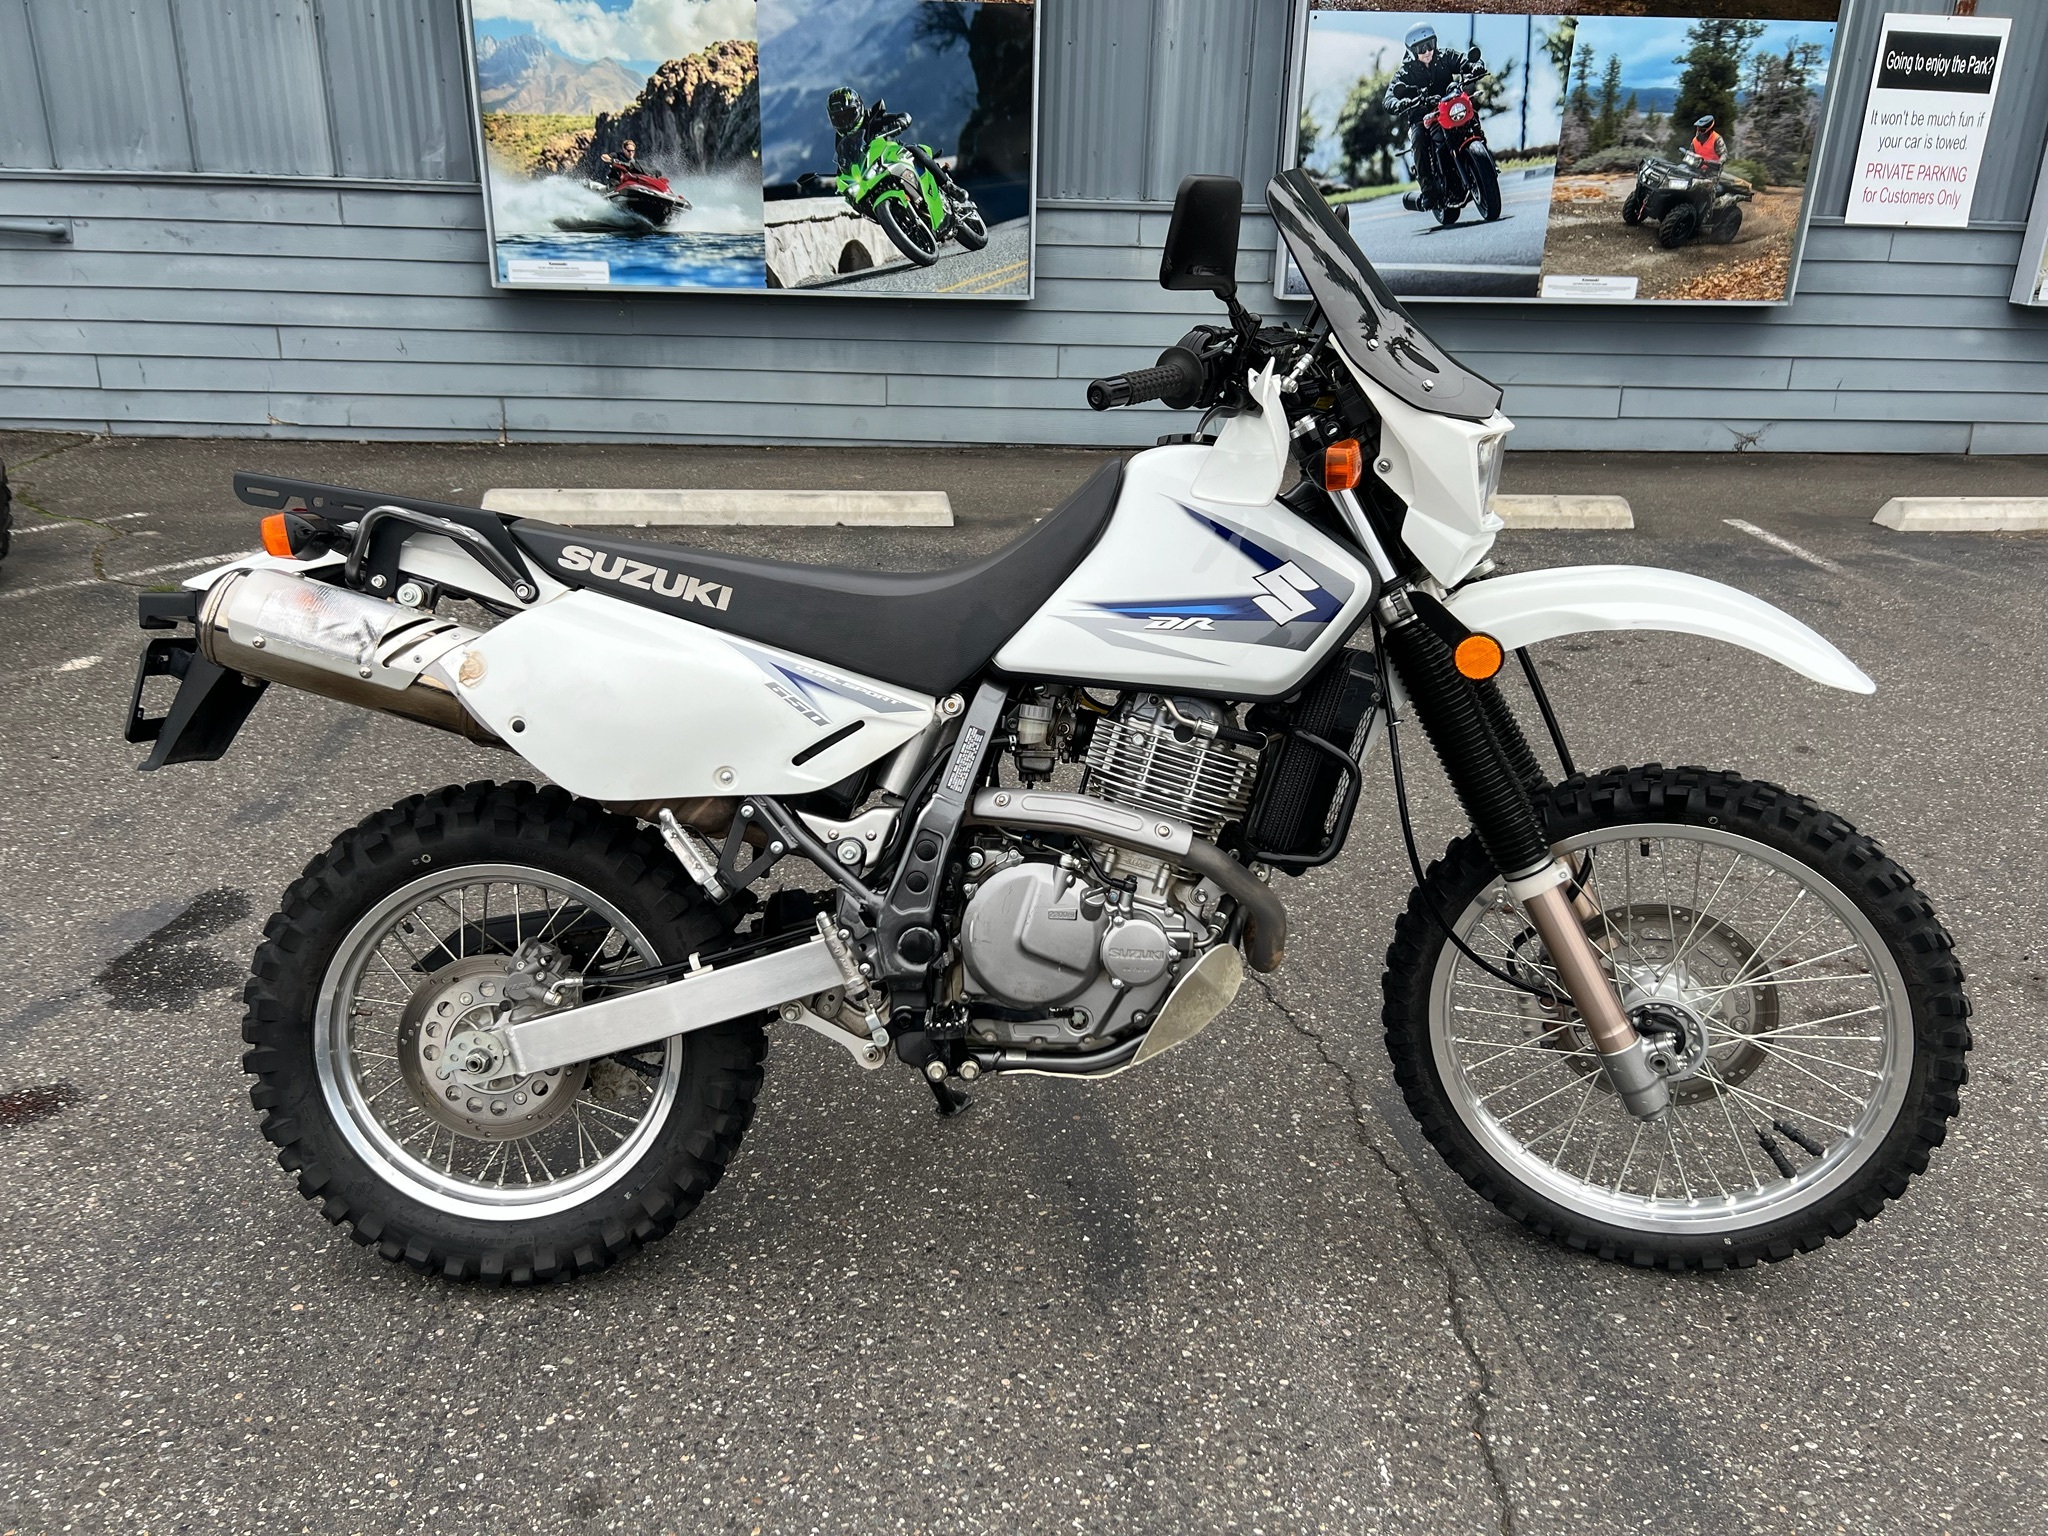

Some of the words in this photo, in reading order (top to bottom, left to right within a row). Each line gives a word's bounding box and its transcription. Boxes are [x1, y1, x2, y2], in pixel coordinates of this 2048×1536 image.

[1887, 51, 1914, 74] Going
[1915, 53, 1924, 71] to
[1926, 54, 1950, 76] enjoy
[1951, 54, 1966, 73] the
[1967, 56, 1994, 75] Park?
[1871, 109, 1879, 125] It
[1881, 110, 1909, 126] won't
[1911, 111, 1924, 126] be
[1927, 112, 1956, 127] much
[1958, 112, 1973, 127] fun
[1976, 112, 1986, 128] if
[1878, 135, 1902, 152] your
[1905, 136, 1922, 148] car
[1924, 134, 1933, 149] is
[1936, 135, 1968, 150] towed.
[1865, 163, 1915, 180] PRIVATE
[1917, 165, 1968, 182] PARKING
[1862, 187, 1877, 203] for
[1879, 187, 1934, 205] Customers
[1937, 189, 1961, 209] Only
[557, 545, 733, 611] SUZUKI
[1144, 616, 1216, 631] DR
[795, 664, 841, 685] DUAL
[839, 681, 902, 705] SPORT
[764, 682, 831, 727] 650
[1109, 948, 1164, 961] SUZUKI
